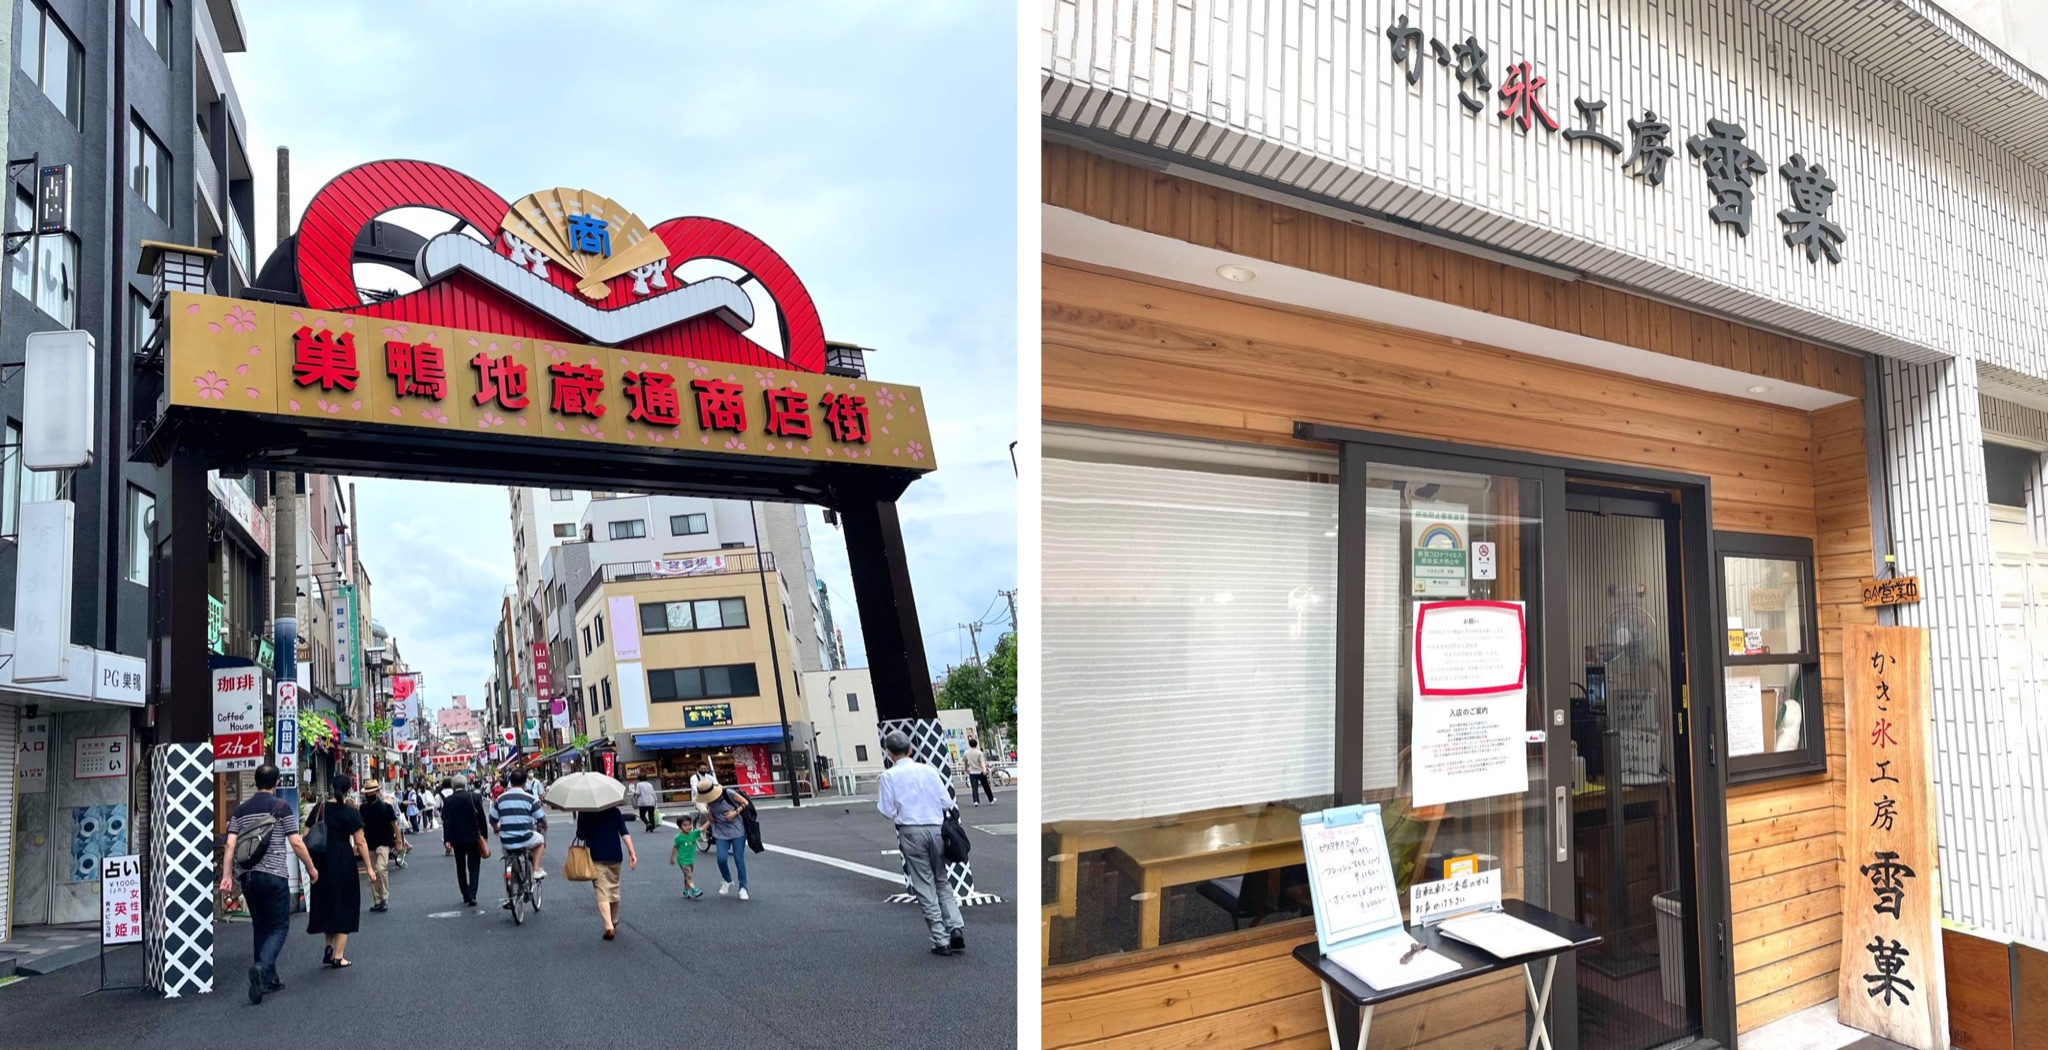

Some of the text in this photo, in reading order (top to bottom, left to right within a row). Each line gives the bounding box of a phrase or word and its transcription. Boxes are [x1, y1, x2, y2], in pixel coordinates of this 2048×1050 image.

[567, 213, 612, 258] 商
[292, 325, 874, 444] 巣鴨地蔵通商店街
[1418, 550, 1463, 559] 新型コロナウイルス
[1420, 557, 1460, 566] 感染拡大防止中
[1863, 578, 1918, 604] 只今営業中
[1729, 634, 1743, 643] Retty
[103, 668, 142, 692] PG 巣鴨
[535, 648, 549, 697] 山和証券
[216, 674, 255, 693] 珈琲
[217, 712, 245, 723] Coffee
[1449, 706, 1489, 718] 入店のご案内
[229, 721, 254, 732] House
[20, 741, 45, 753] 入口
[217, 736, 259, 756] スカイ
[110, 741, 121, 771] 占い
[226, 759, 256, 769] 地下1階
[105, 860, 139, 879] 占い
[114, 901, 128, 938] 英姫
[130, 889, 140, 936] 女性専用
